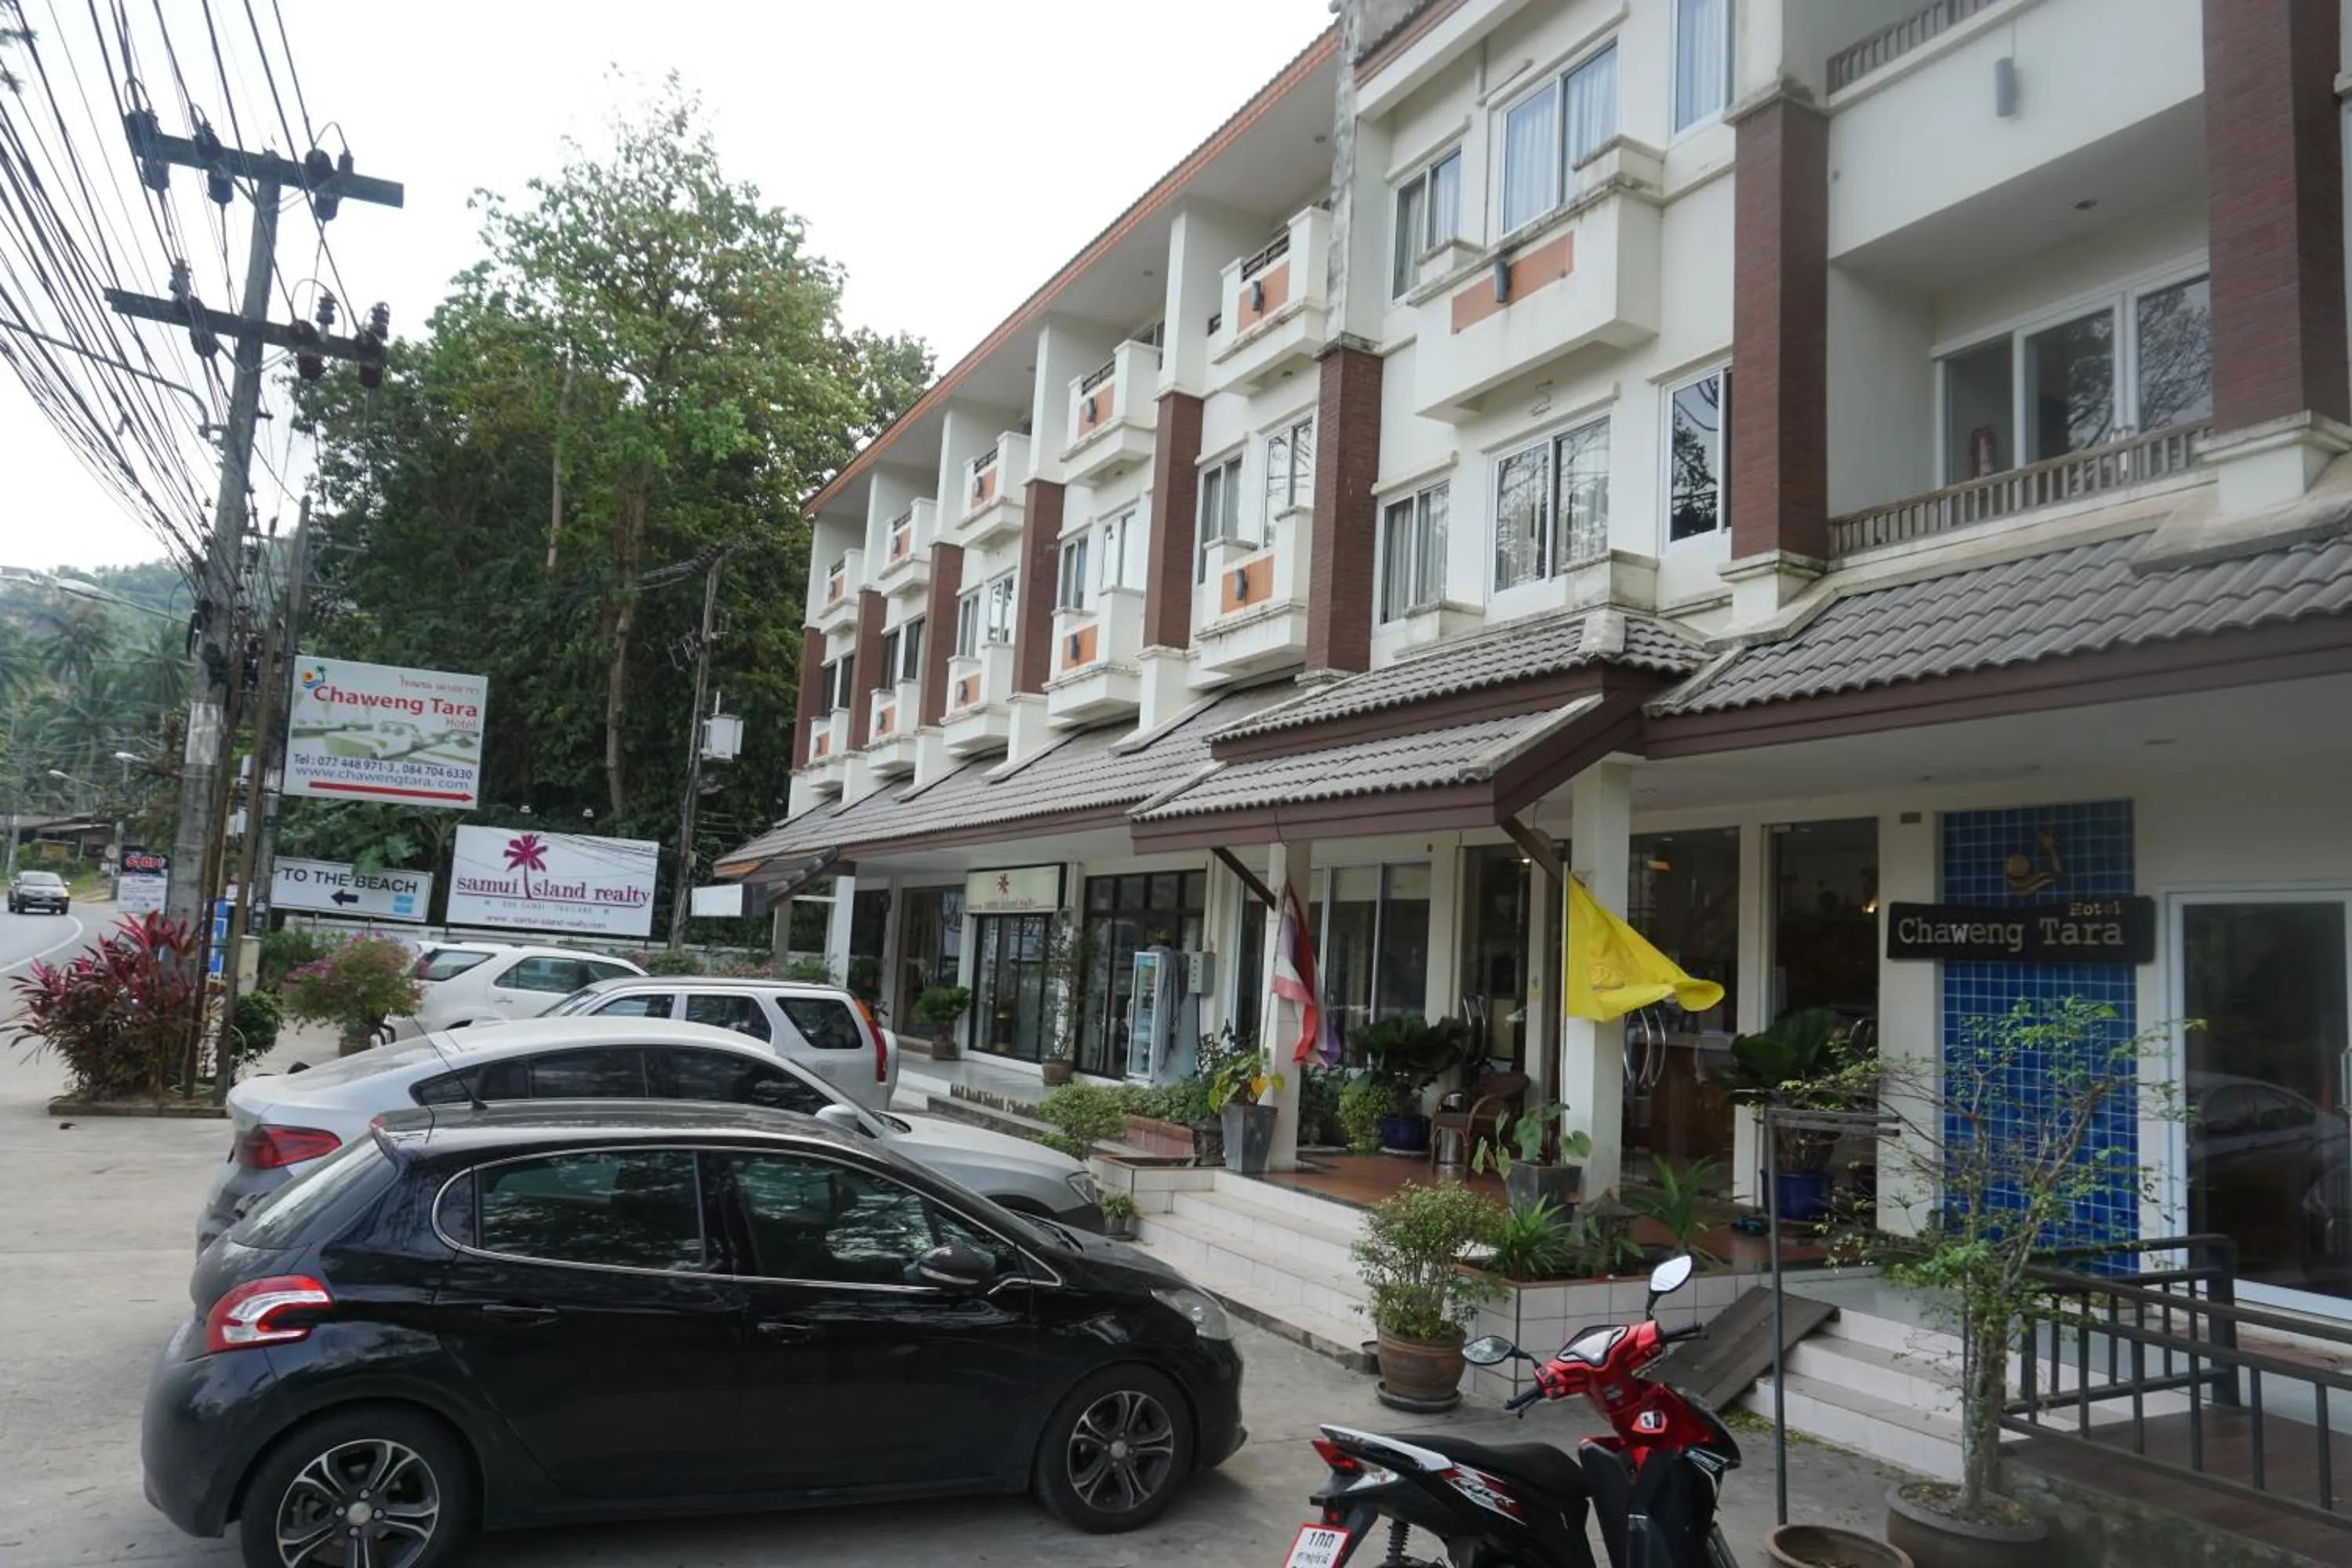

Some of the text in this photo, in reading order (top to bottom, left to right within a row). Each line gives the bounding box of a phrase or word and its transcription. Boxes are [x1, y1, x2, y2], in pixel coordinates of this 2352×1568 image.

[314, 685, 477, 717] Chaweng Tara
[445, 717, 476, 728] Hotel
[282, 868, 418, 894] TO THE BEACH
[457, 876, 517, 895] samui
[593, 885, 650, 903] realty
[2069, 900, 2122, 917] Hotel
[1897, 917, 2124, 952] Chaweng Tara
